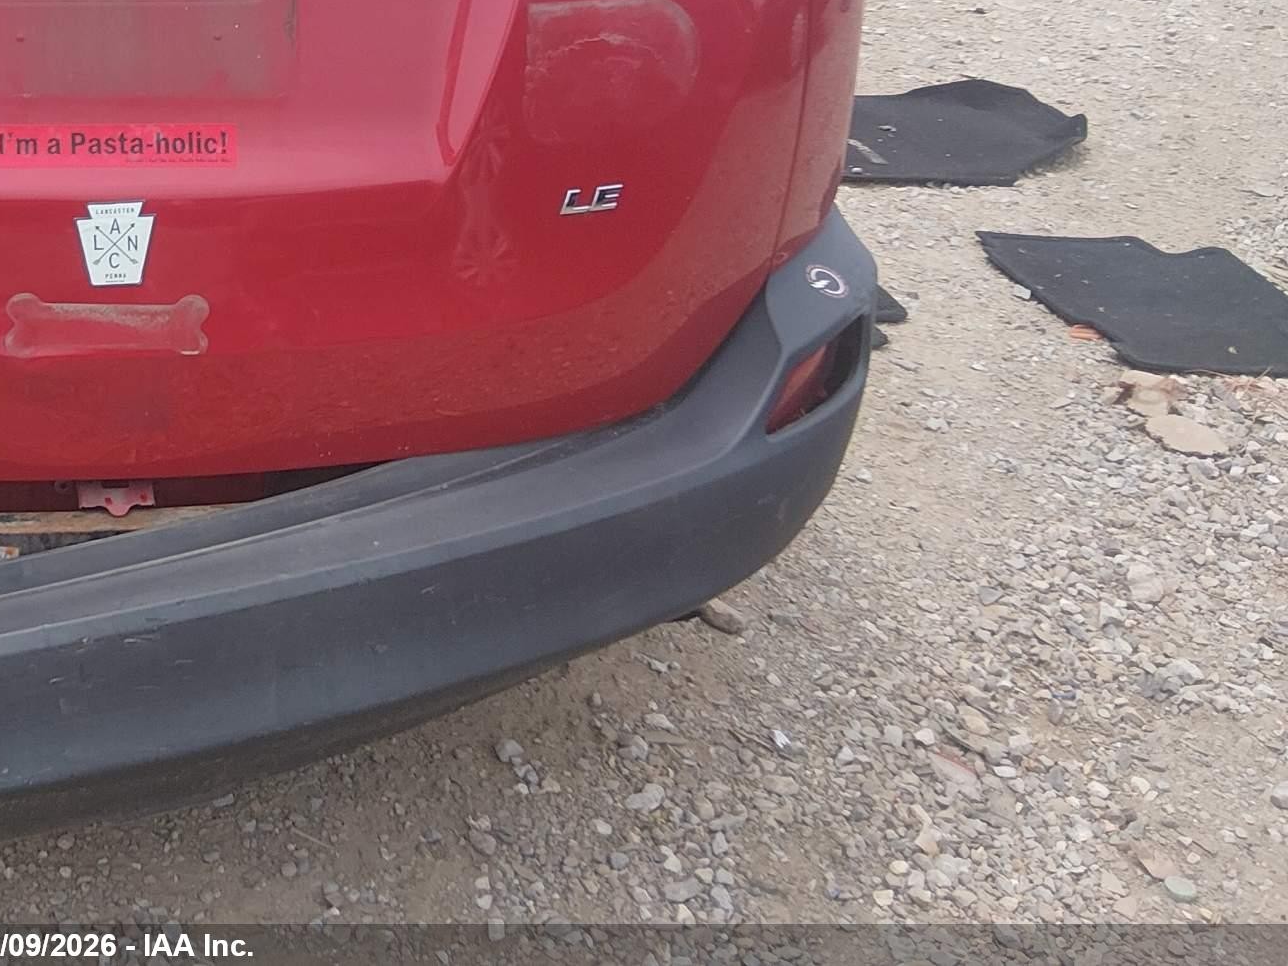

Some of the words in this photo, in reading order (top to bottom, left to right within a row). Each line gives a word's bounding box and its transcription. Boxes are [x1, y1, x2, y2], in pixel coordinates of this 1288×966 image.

[47, 137, 61, 155] a
[71, 130, 227, 155] Pasta-holic!
[559, 184, 623, 215] LE
